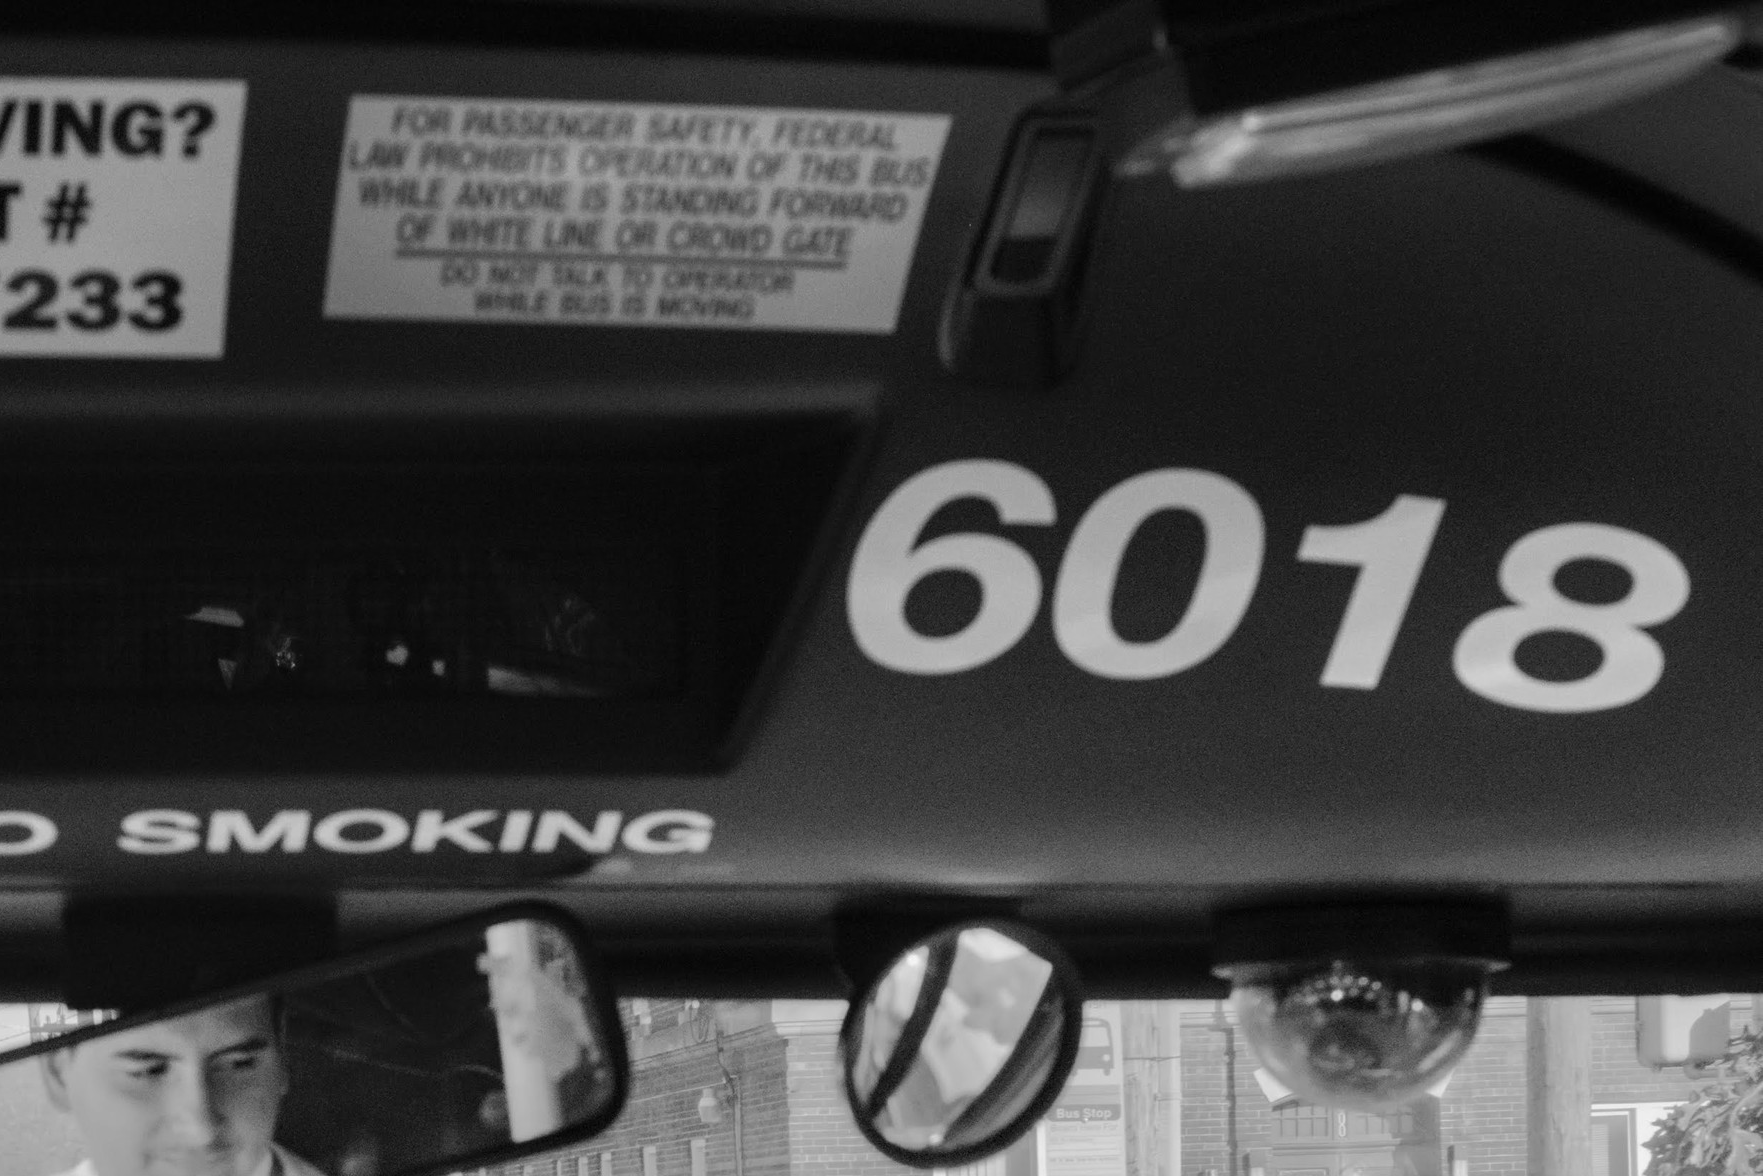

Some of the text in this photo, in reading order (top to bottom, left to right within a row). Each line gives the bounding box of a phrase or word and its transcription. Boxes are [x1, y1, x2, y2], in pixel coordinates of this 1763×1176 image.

[391, 105, 452, 137] FOR
[461, 107, 635, 141] PASSENGER
[769, 115, 900, 151] FEDERAL
[348, 139, 931, 189] LAW PROHIBITS OPERATION OF THIS BUS
[42, 183, 91, 242] #
[358, 176, 909, 223] WHILE ANYONE IS STANDING FORWARD
[395, 212, 853, 258] OF WHITE LINE OR CROWD GATE
[847, 458, 1692, 714] 6018
[116, 808, 715, 857] SMOKING
[1056, 1106, 1113, 1121] Bus Stop
